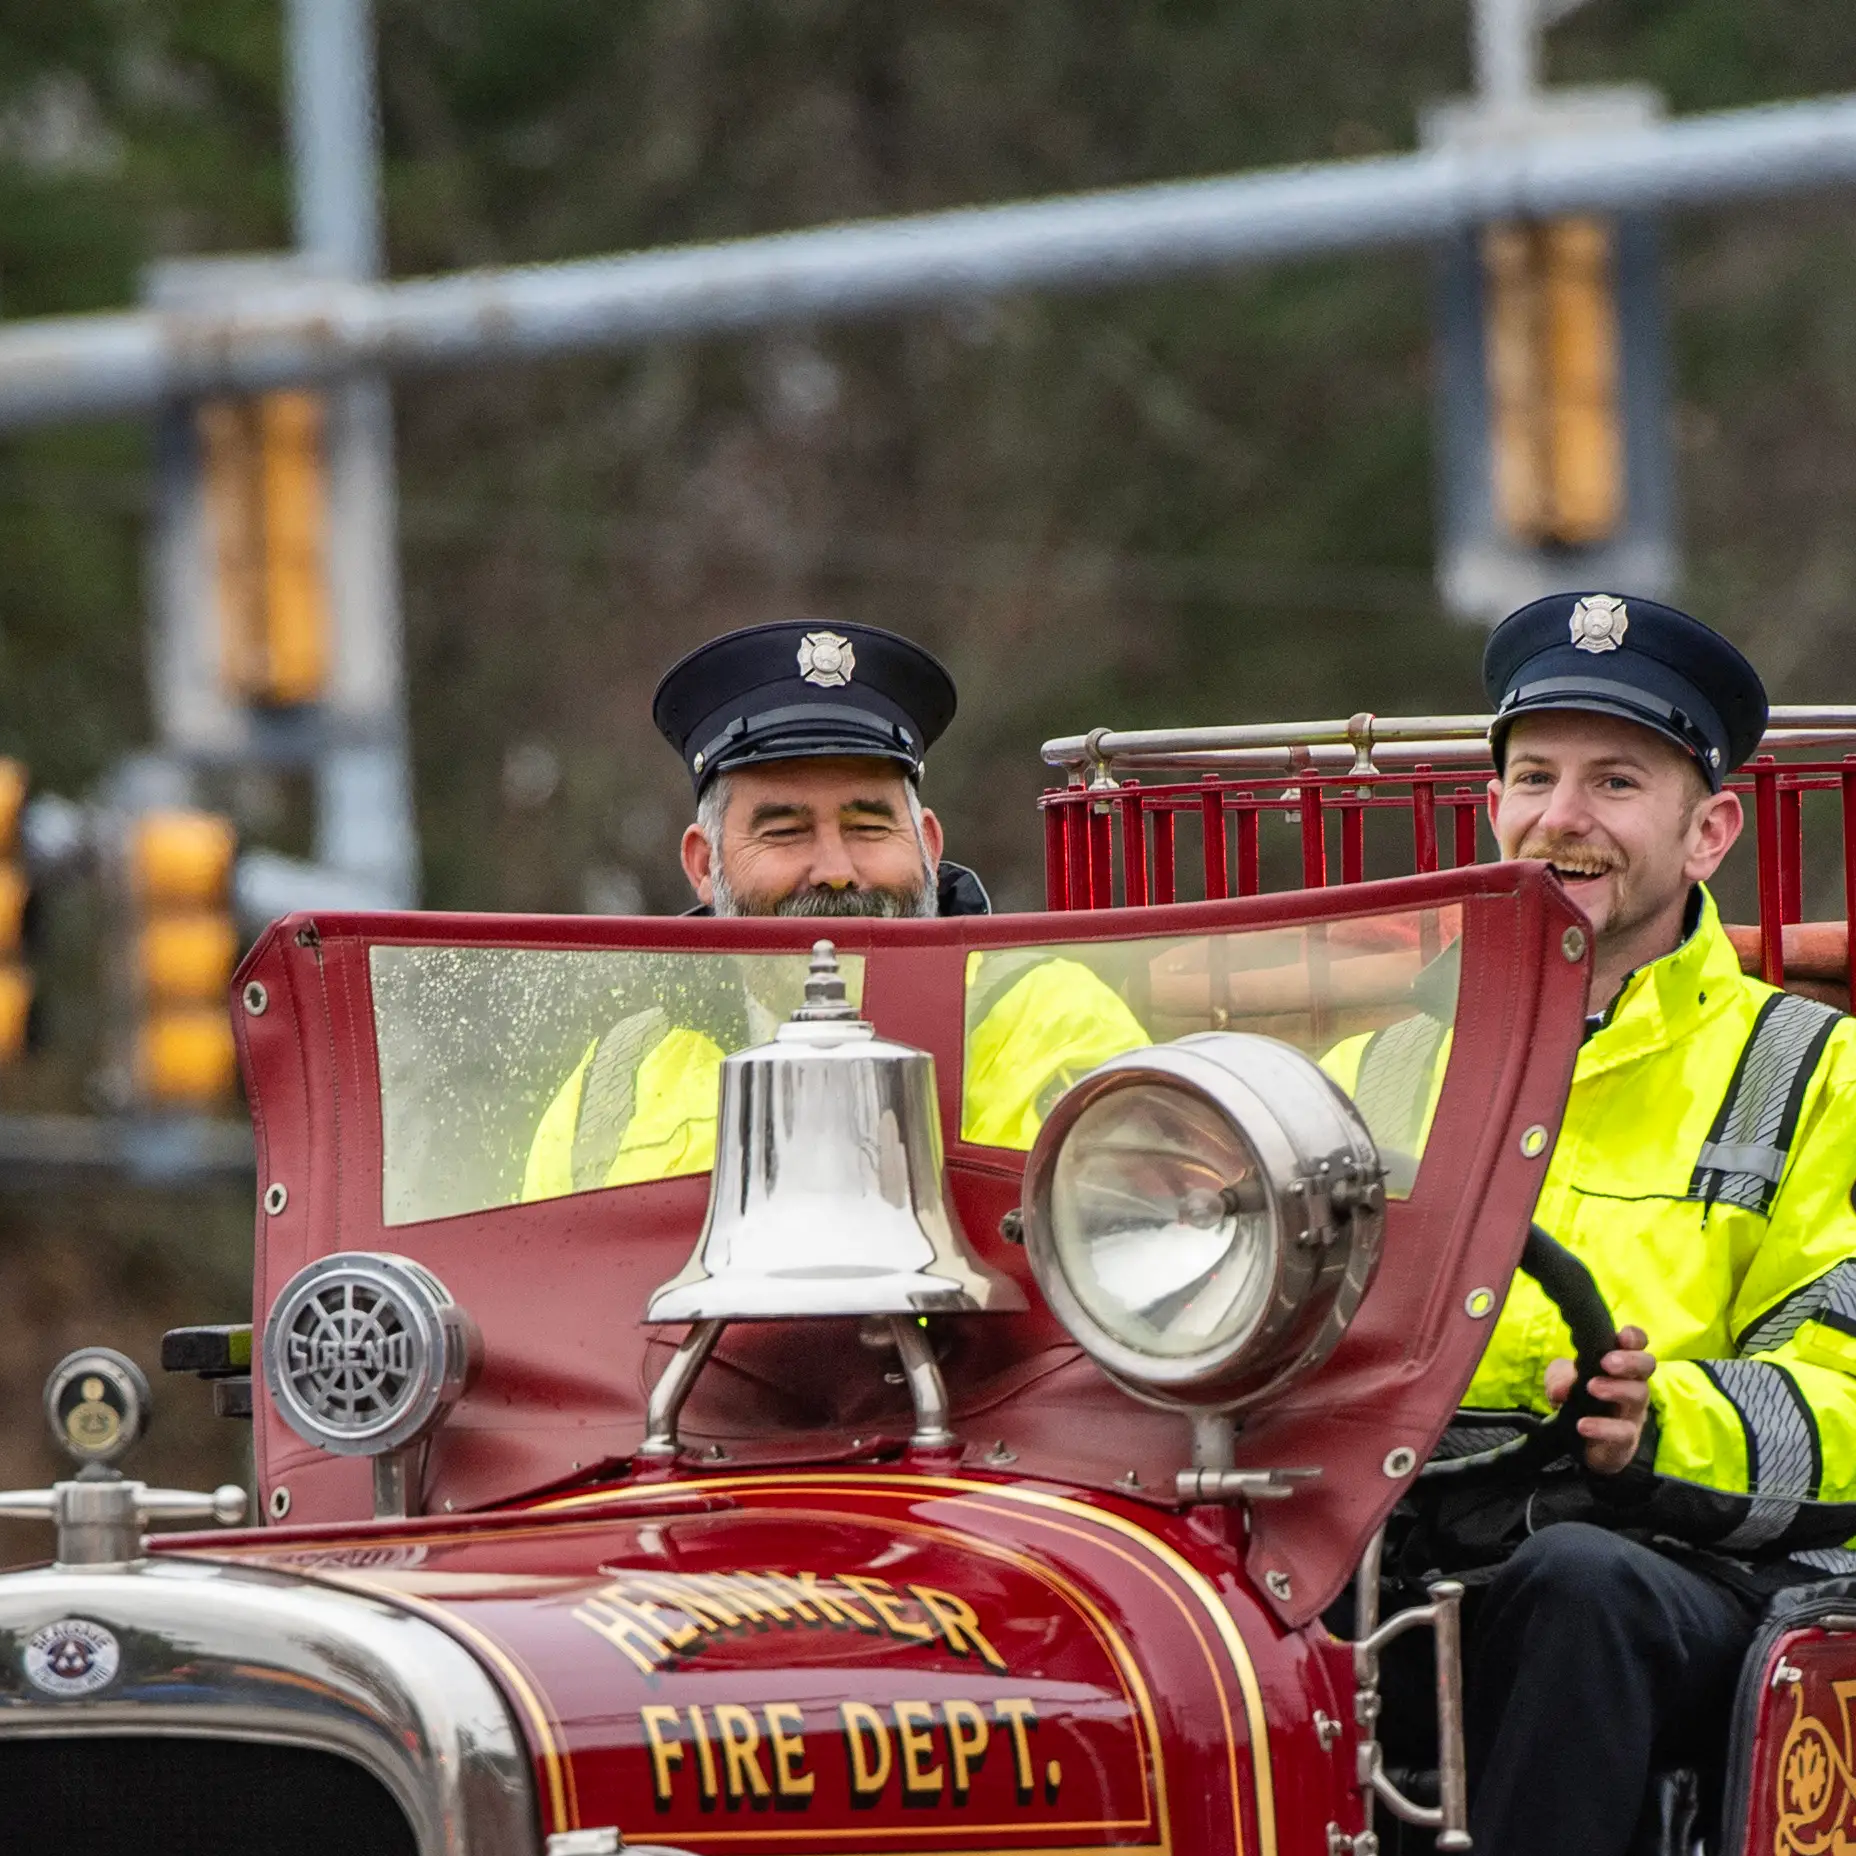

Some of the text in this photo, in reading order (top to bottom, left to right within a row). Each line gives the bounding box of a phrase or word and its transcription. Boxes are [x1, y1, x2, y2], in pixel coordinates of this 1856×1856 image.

[289, 1330, 409, 1380] SIRENO
[570, 1570, 1009, 1676] HENNIKER
[641, 1697, 1064, 1804] FIRE DEPT.
